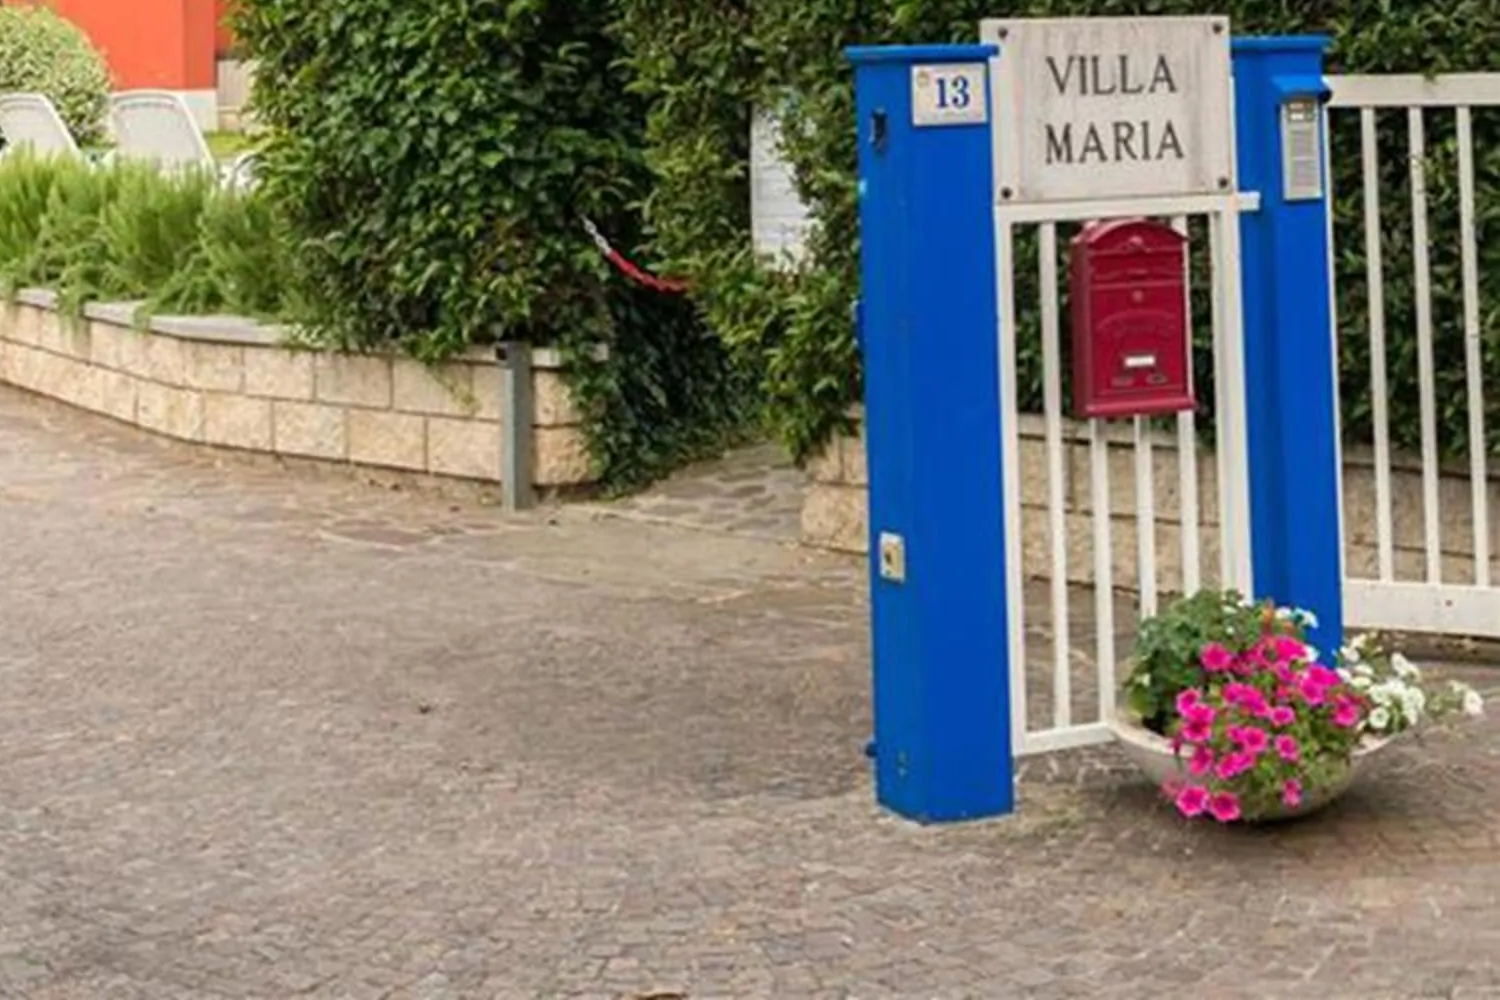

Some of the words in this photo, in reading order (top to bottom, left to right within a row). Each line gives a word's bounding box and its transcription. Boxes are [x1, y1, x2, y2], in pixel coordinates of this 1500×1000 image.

[935, 75, 971, 109] 13
[1045, 55, 1177, 96] VILLA
[1044, 120, 1185, 165] MARIA
